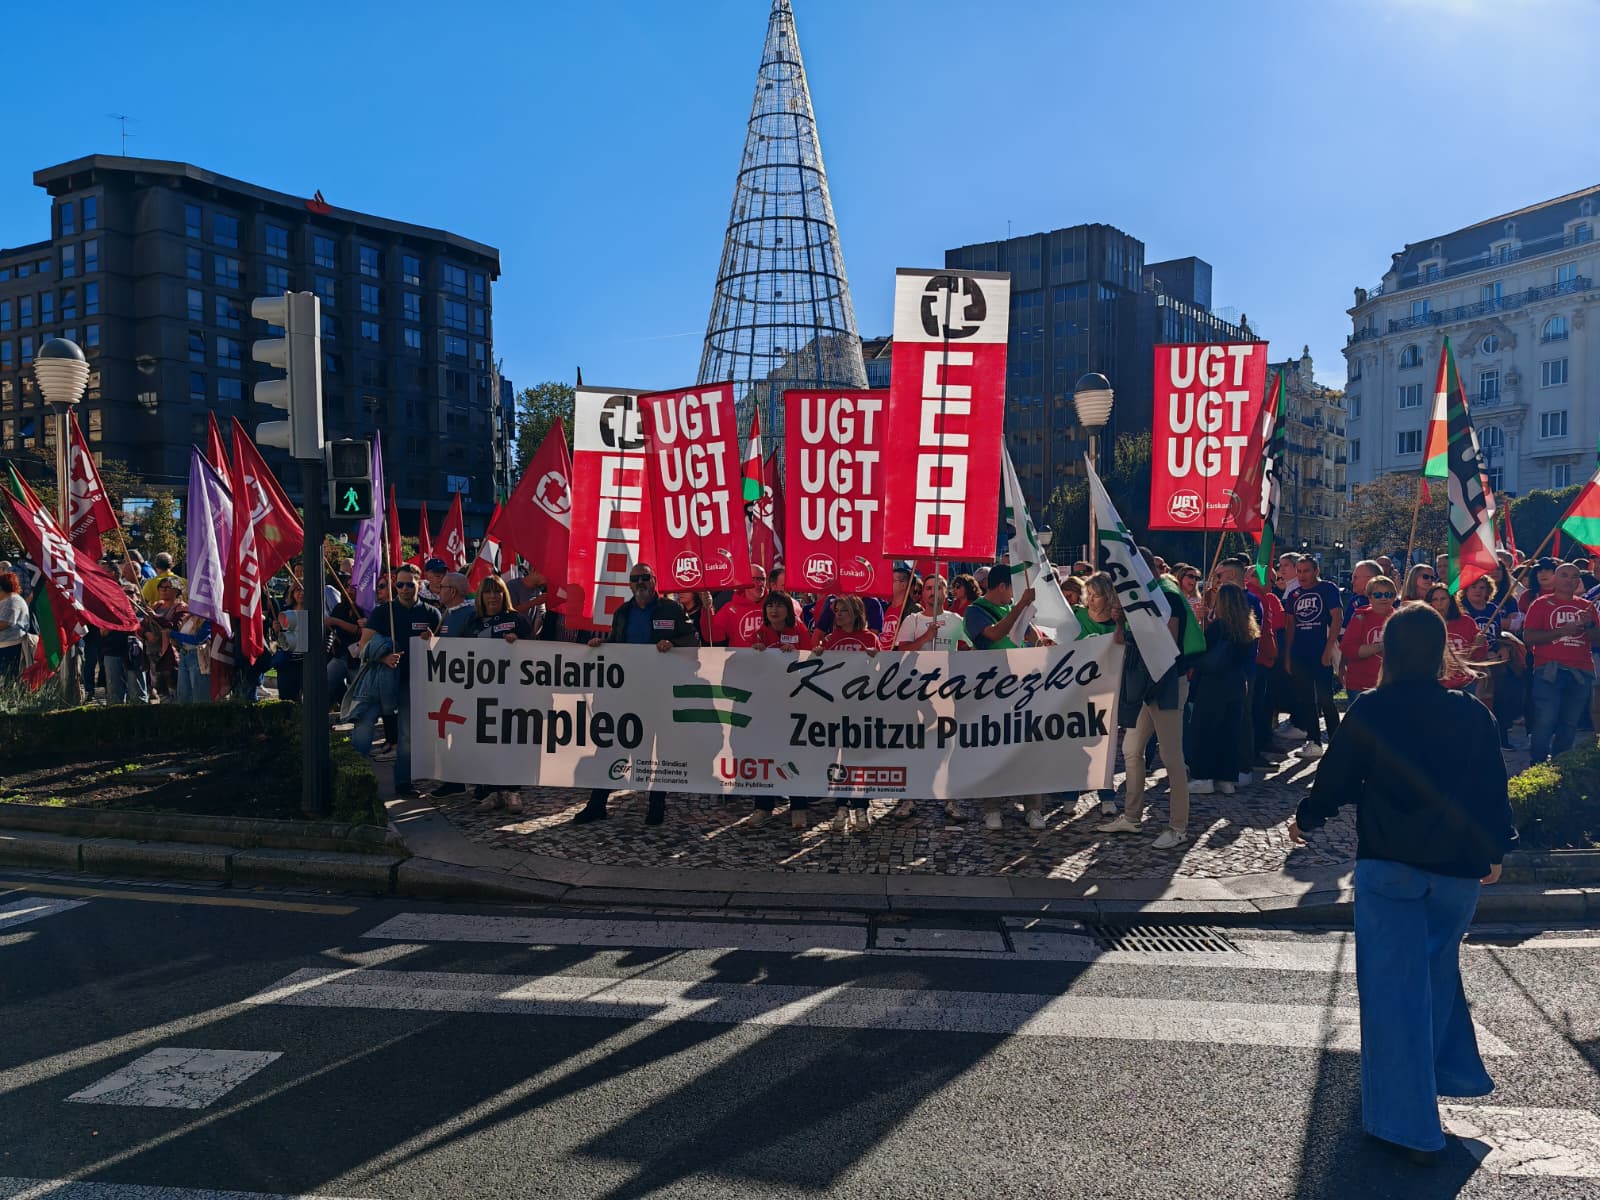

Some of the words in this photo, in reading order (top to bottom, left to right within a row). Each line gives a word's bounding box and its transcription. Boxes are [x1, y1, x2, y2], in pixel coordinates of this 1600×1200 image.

[1170, 345, 1254, 389] UGT
[652, 391, 723, 444] UGT
[800, 398, 882, 444] UGT
[1169, 390, 1250, 434] UGT
[659, 441, 726, 493] UGT
[800, 449, 880, 495] UGT
[1167, 435, 1248, 478] UGT
[664, 490, 730, 539] UGT
[800, 497, 878, 543] UGT
[1172, 495, 1198, 509] UGT
[676, 557, 698, 573] UGT
[807, 559, 833, 575] UGT
[840, 568, 865, 577] Euskadi
[1297, 597, 1317, 611] UGT
[427, 650, 511, 690] Mejor
[519, 654, 625, 689] salario
[787, 649, 1101, 711] Kalitatezko
[476, 697, 644, 754] Empleo
[789, 712, 925, 750] Zerbitzu
[937, 702, 1109, 749] Publikoak
[721, 757, 775, 780] UGT
[851, 770, 903, 782] CCOO
